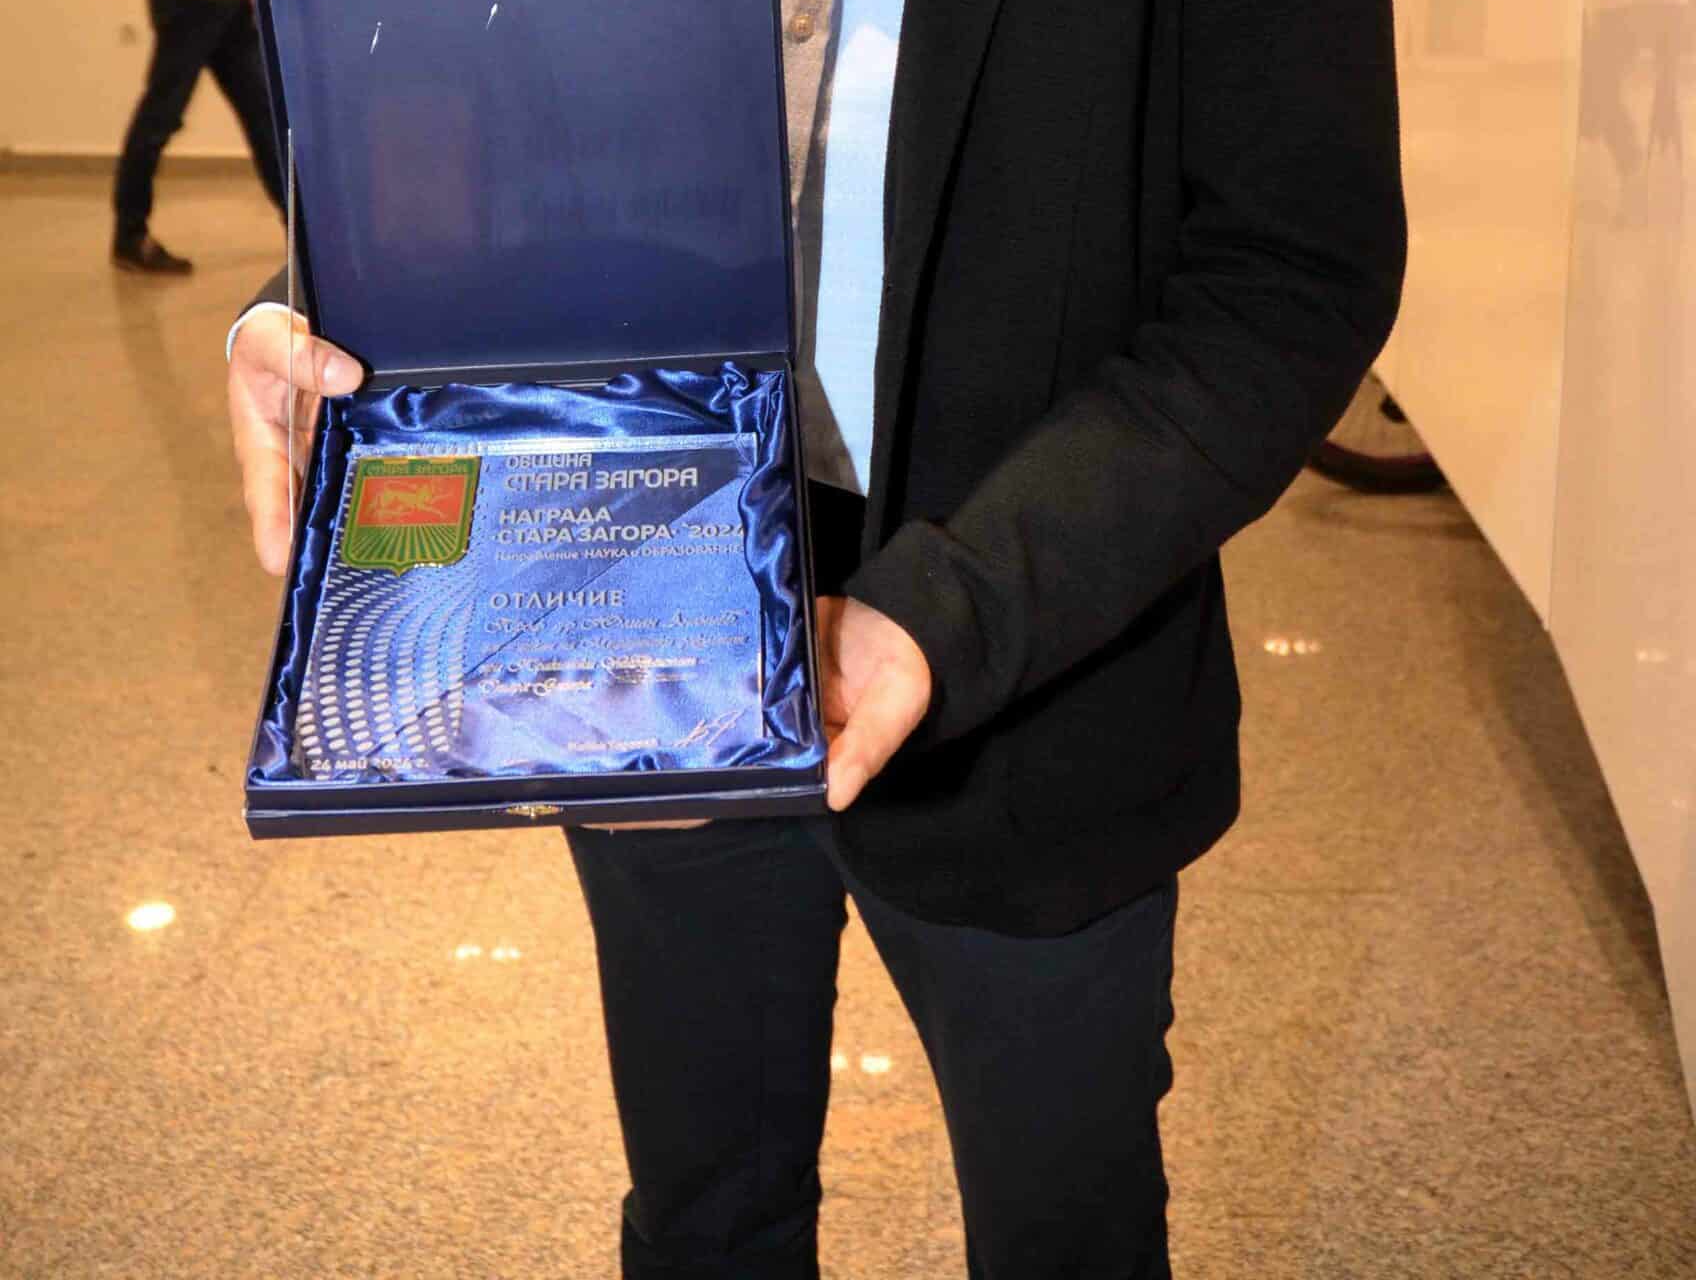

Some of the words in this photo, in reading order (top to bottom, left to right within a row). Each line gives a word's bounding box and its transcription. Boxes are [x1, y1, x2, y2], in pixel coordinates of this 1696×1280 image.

[505, 471, 588, 491] СТАРА
[595, 467, 698, 489] ЗАГОРА
[499, 506, 612, 525] НАГРАДА
[584, 547, 628, 560] НАУКА
[490, 589, 625, 609] ОТЛИЧИЕ
